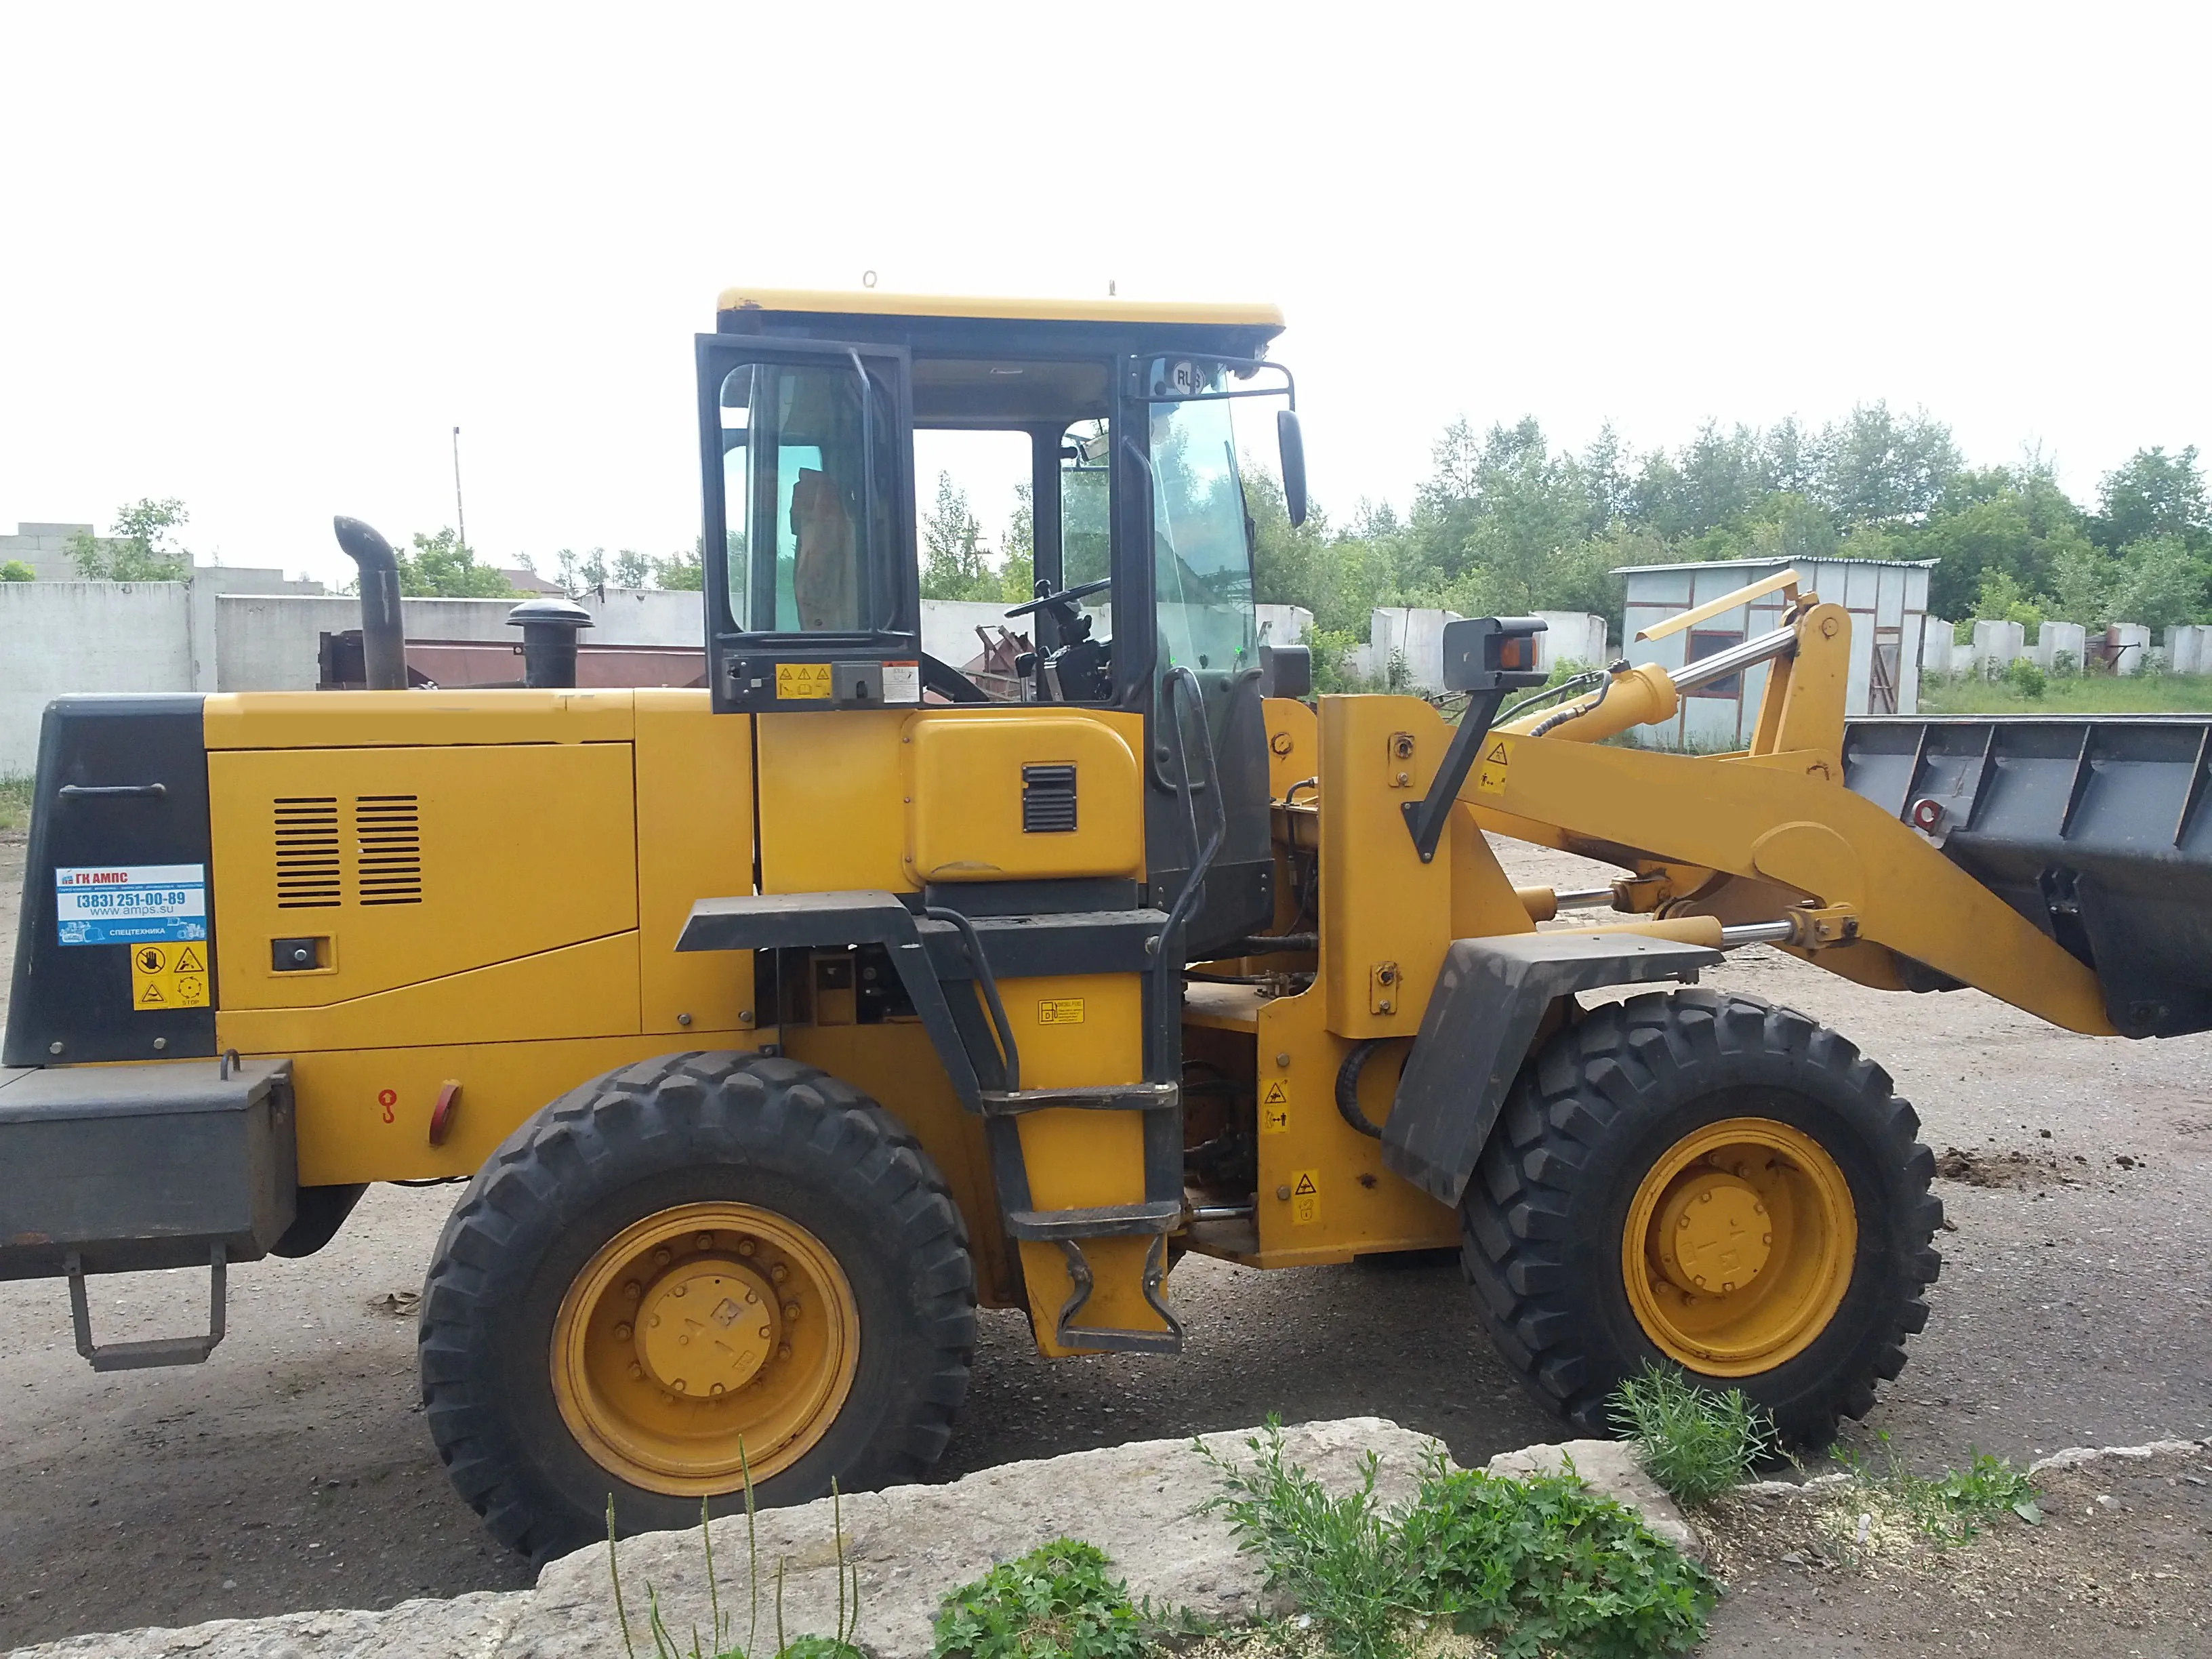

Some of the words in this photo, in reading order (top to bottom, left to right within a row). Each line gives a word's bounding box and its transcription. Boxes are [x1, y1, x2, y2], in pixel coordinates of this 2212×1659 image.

[76, 874, 90, 884] ГК
[93, 872, 128, 884] АМПС
[117, 892, 186, 907] 251-00-89
[90, 905, 173, 916] www.amps.su
[109, 928, 166, 937] СПЕЦТЕХНИКА
